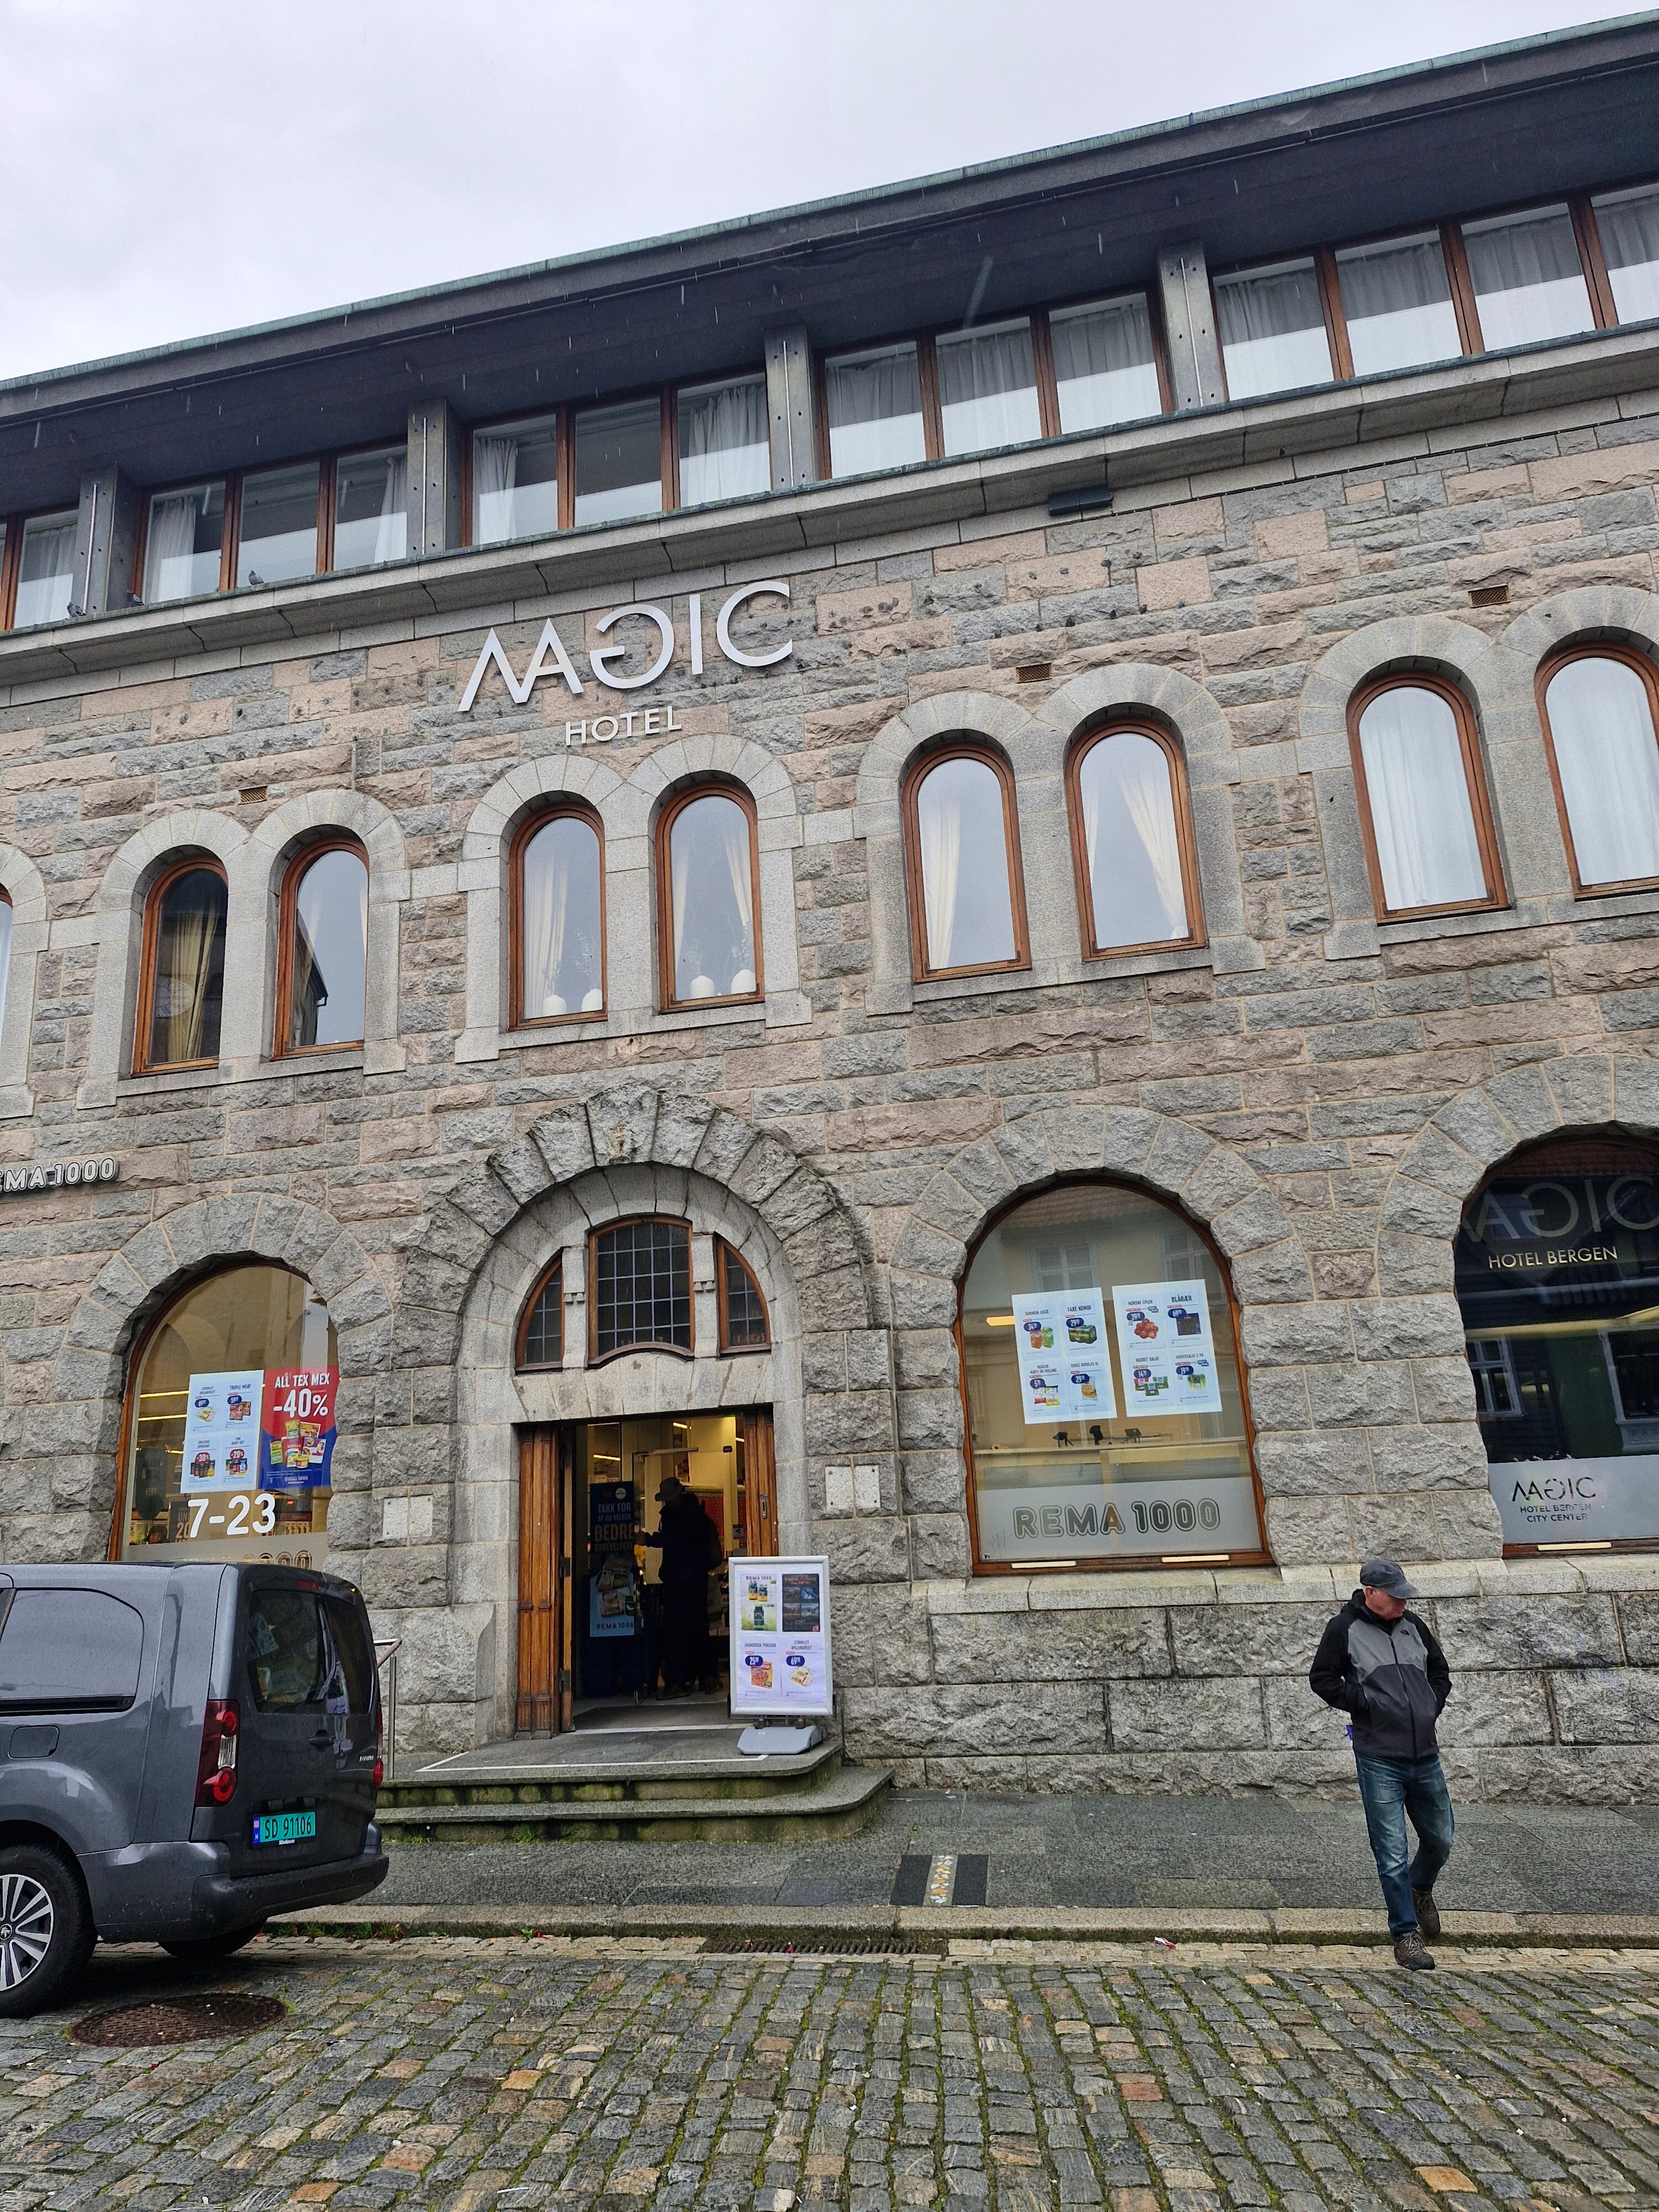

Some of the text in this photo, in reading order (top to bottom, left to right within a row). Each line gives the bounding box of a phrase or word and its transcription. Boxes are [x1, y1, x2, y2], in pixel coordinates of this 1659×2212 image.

[458, 581, 792, 712] MAGIC
[566, 706, 682, 746] HOTEL
[0, 1157, 117, 1192] MA 1000
[1489, 1246, 1618, 1269] HOTEL BERGEN
[275, 1373, 330, 1388] ALL TEX MEX
[273, 1388, 328, 1418] -40%
[1512, 1477, 1596, 1501] MAGIC
[187, 1493, 275, 1538] 7-23
[598, 1502, 631, 1514] TAKK FOR
[1013, 1498, 1220, 1538] REMA 1000
[1551, 1513, 1588, 1521] CENTER
[265, 1815, 311, 1839] SD 91106
